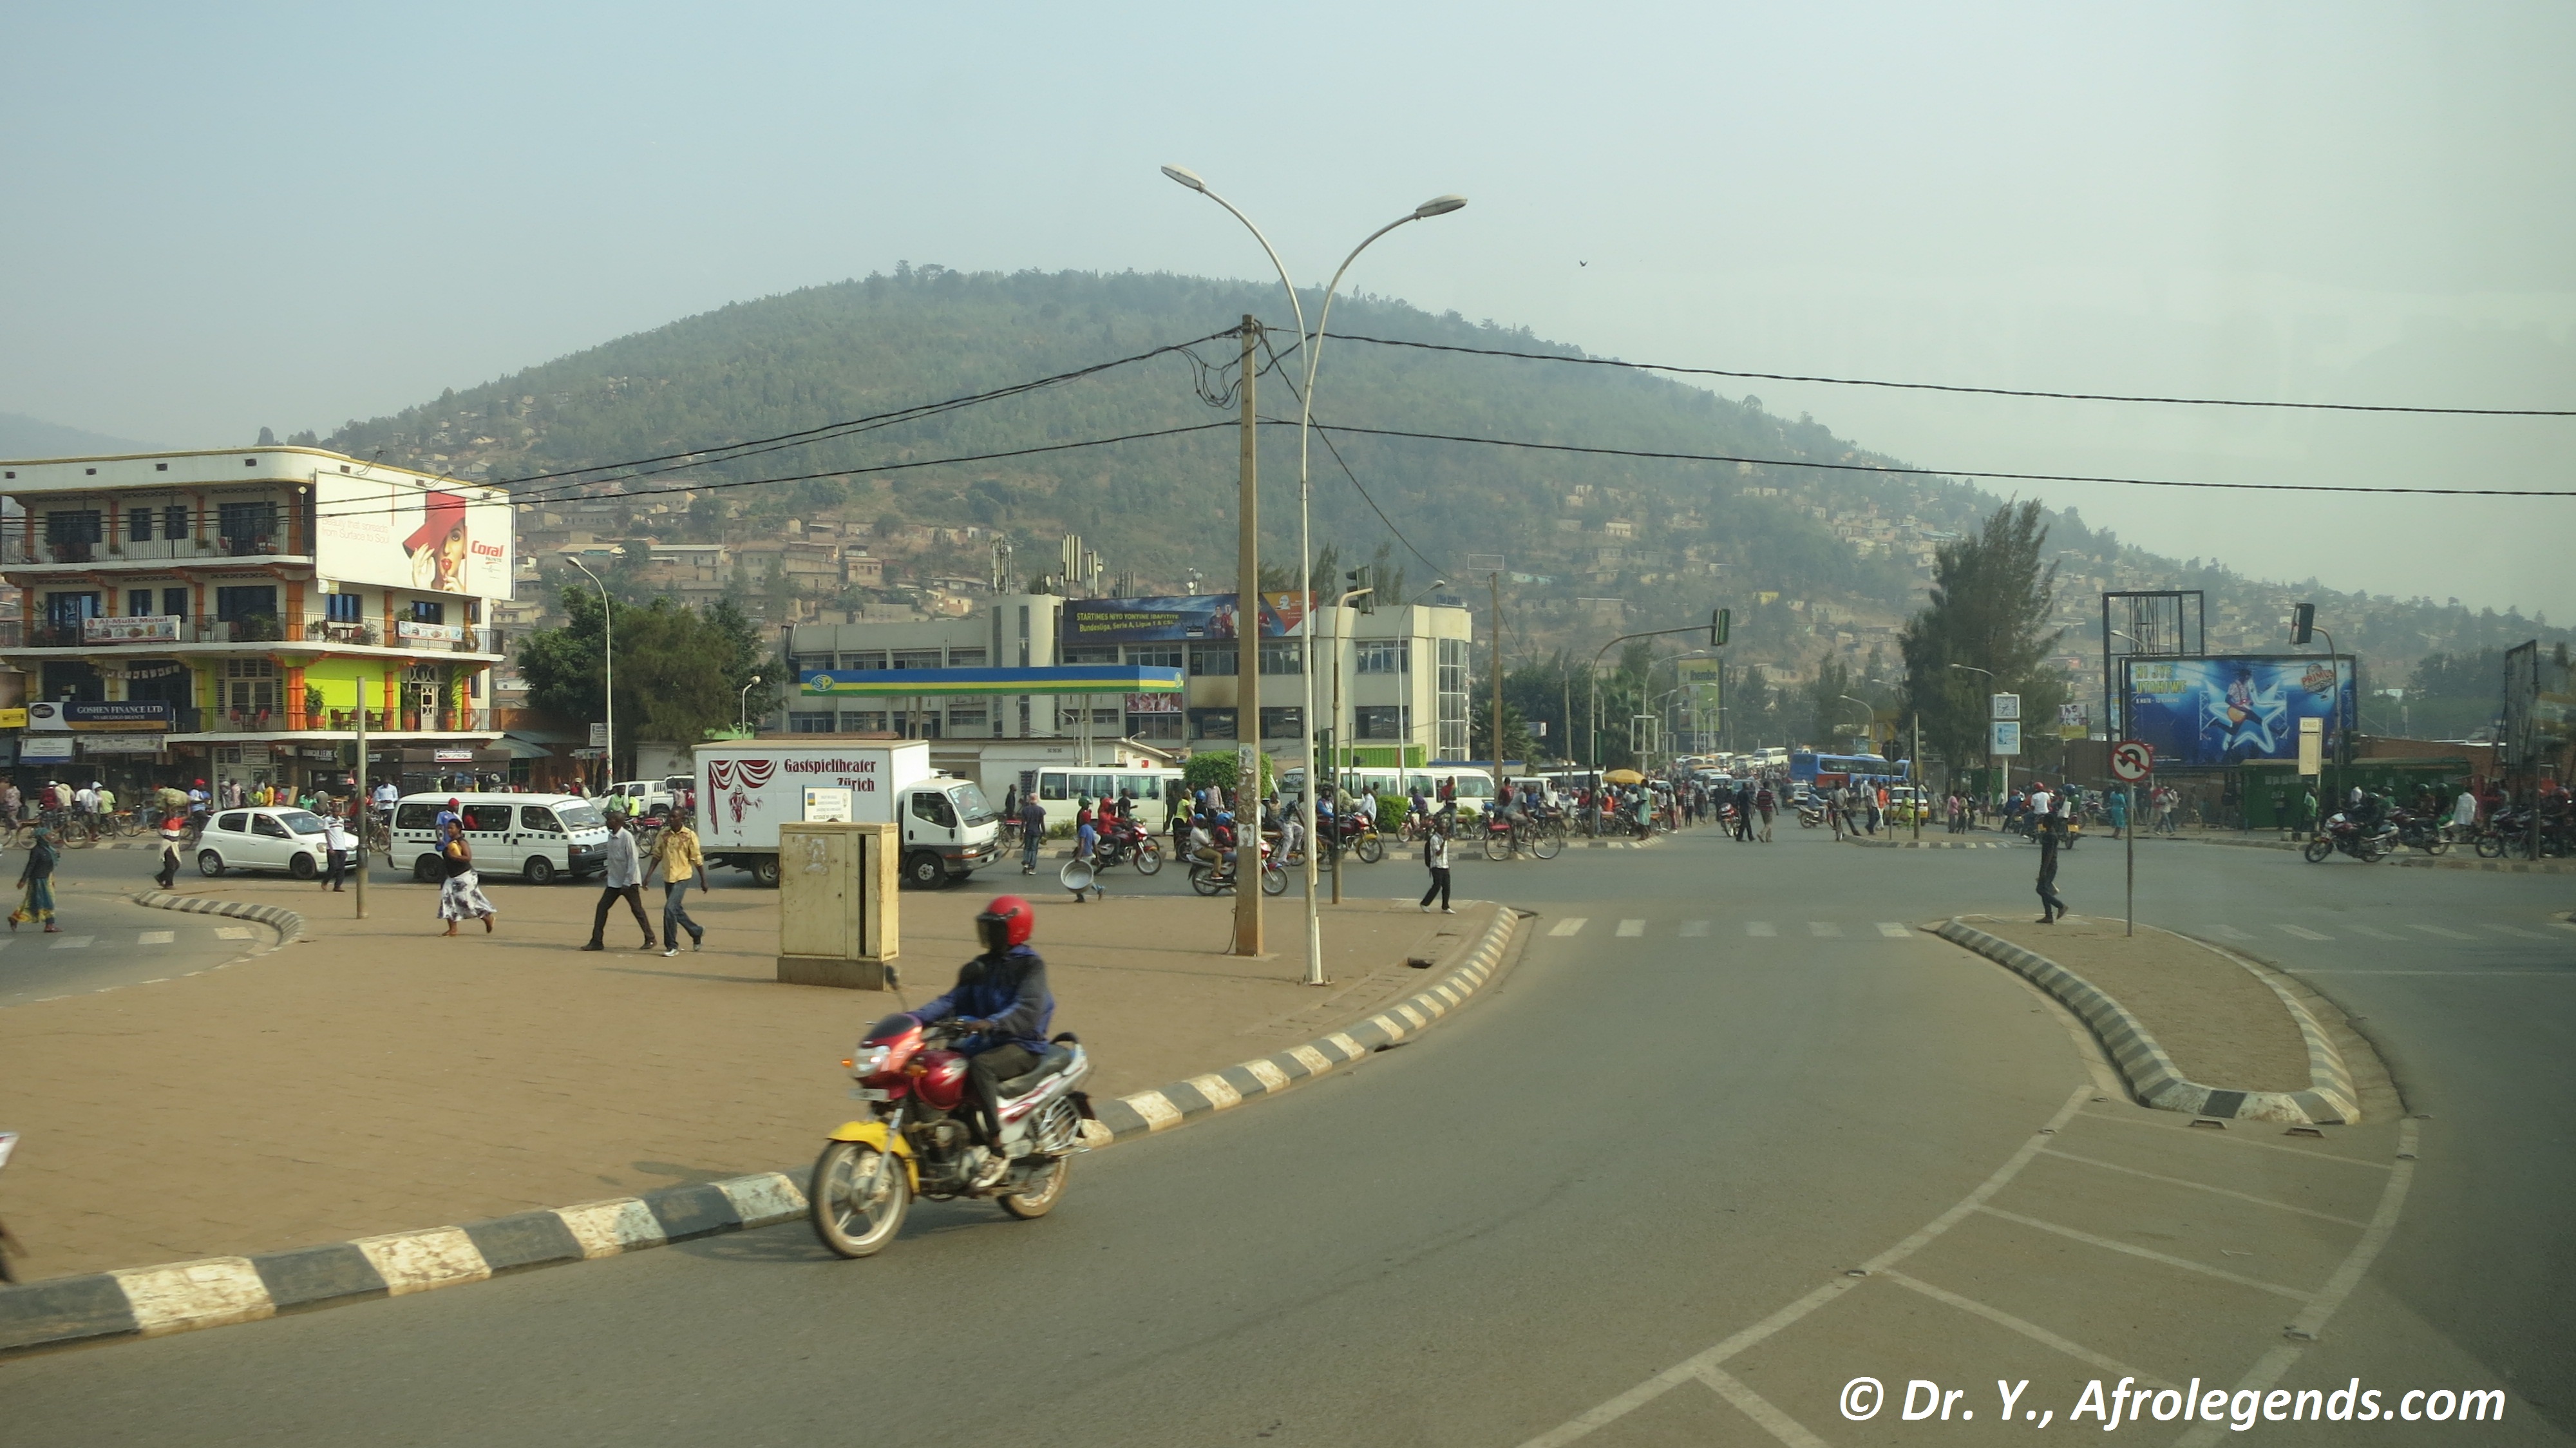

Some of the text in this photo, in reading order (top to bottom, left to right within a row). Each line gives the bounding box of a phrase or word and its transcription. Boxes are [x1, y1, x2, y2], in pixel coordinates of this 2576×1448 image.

[471, 540, 504, 558] Coral
[1079, 623, 1112, 632] Bundesliga,
[2135, 665, 2148, 679] NI
[2301, 669, 2334, 683] PRIMUS
[813, 677, 831, 689] SP
[784, 759, 876, 774] Gastspieltheater
[837, 777, 875, 792] Zürich
